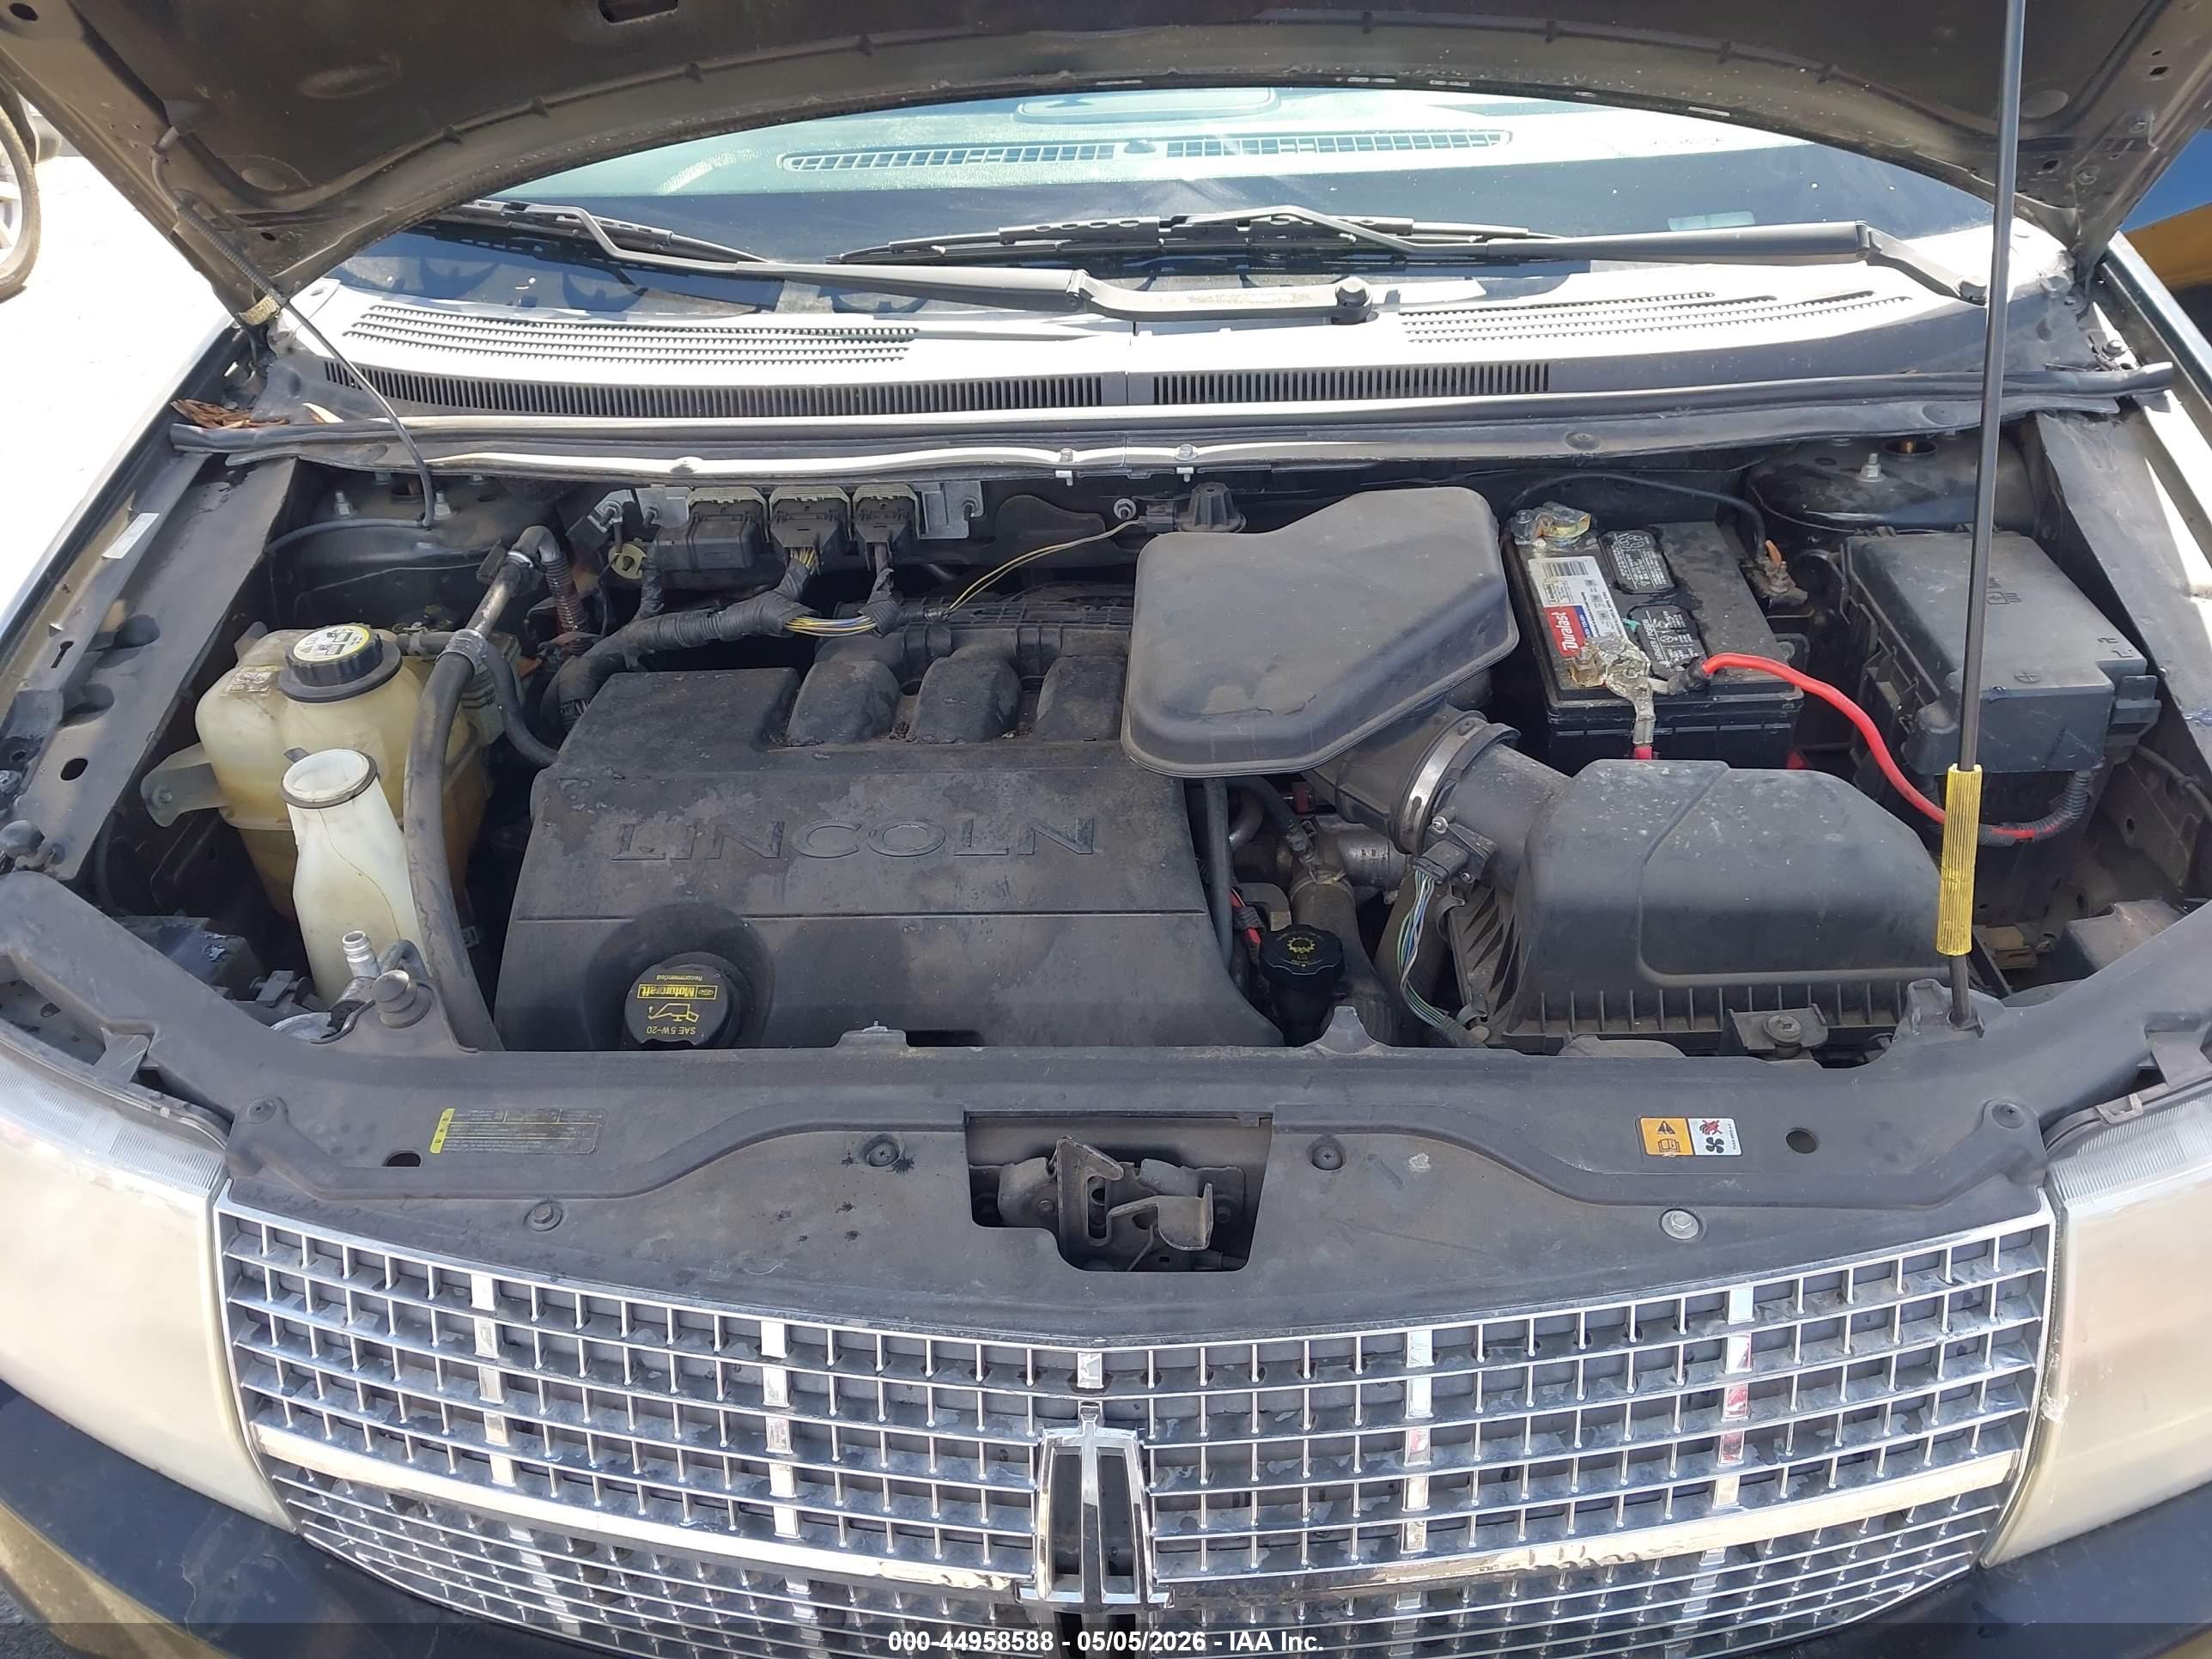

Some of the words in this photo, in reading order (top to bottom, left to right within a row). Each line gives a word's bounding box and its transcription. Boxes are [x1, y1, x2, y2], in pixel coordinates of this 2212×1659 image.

[1551, 611, 1579, 651] Duralast
[611, 817, 1094, 861] LINCOLN
[641, 986, 695, 997] Motorcraft
[646, 1025, 677, 1035] 5W-20
[677, 1025, 696, 1035] SAE
